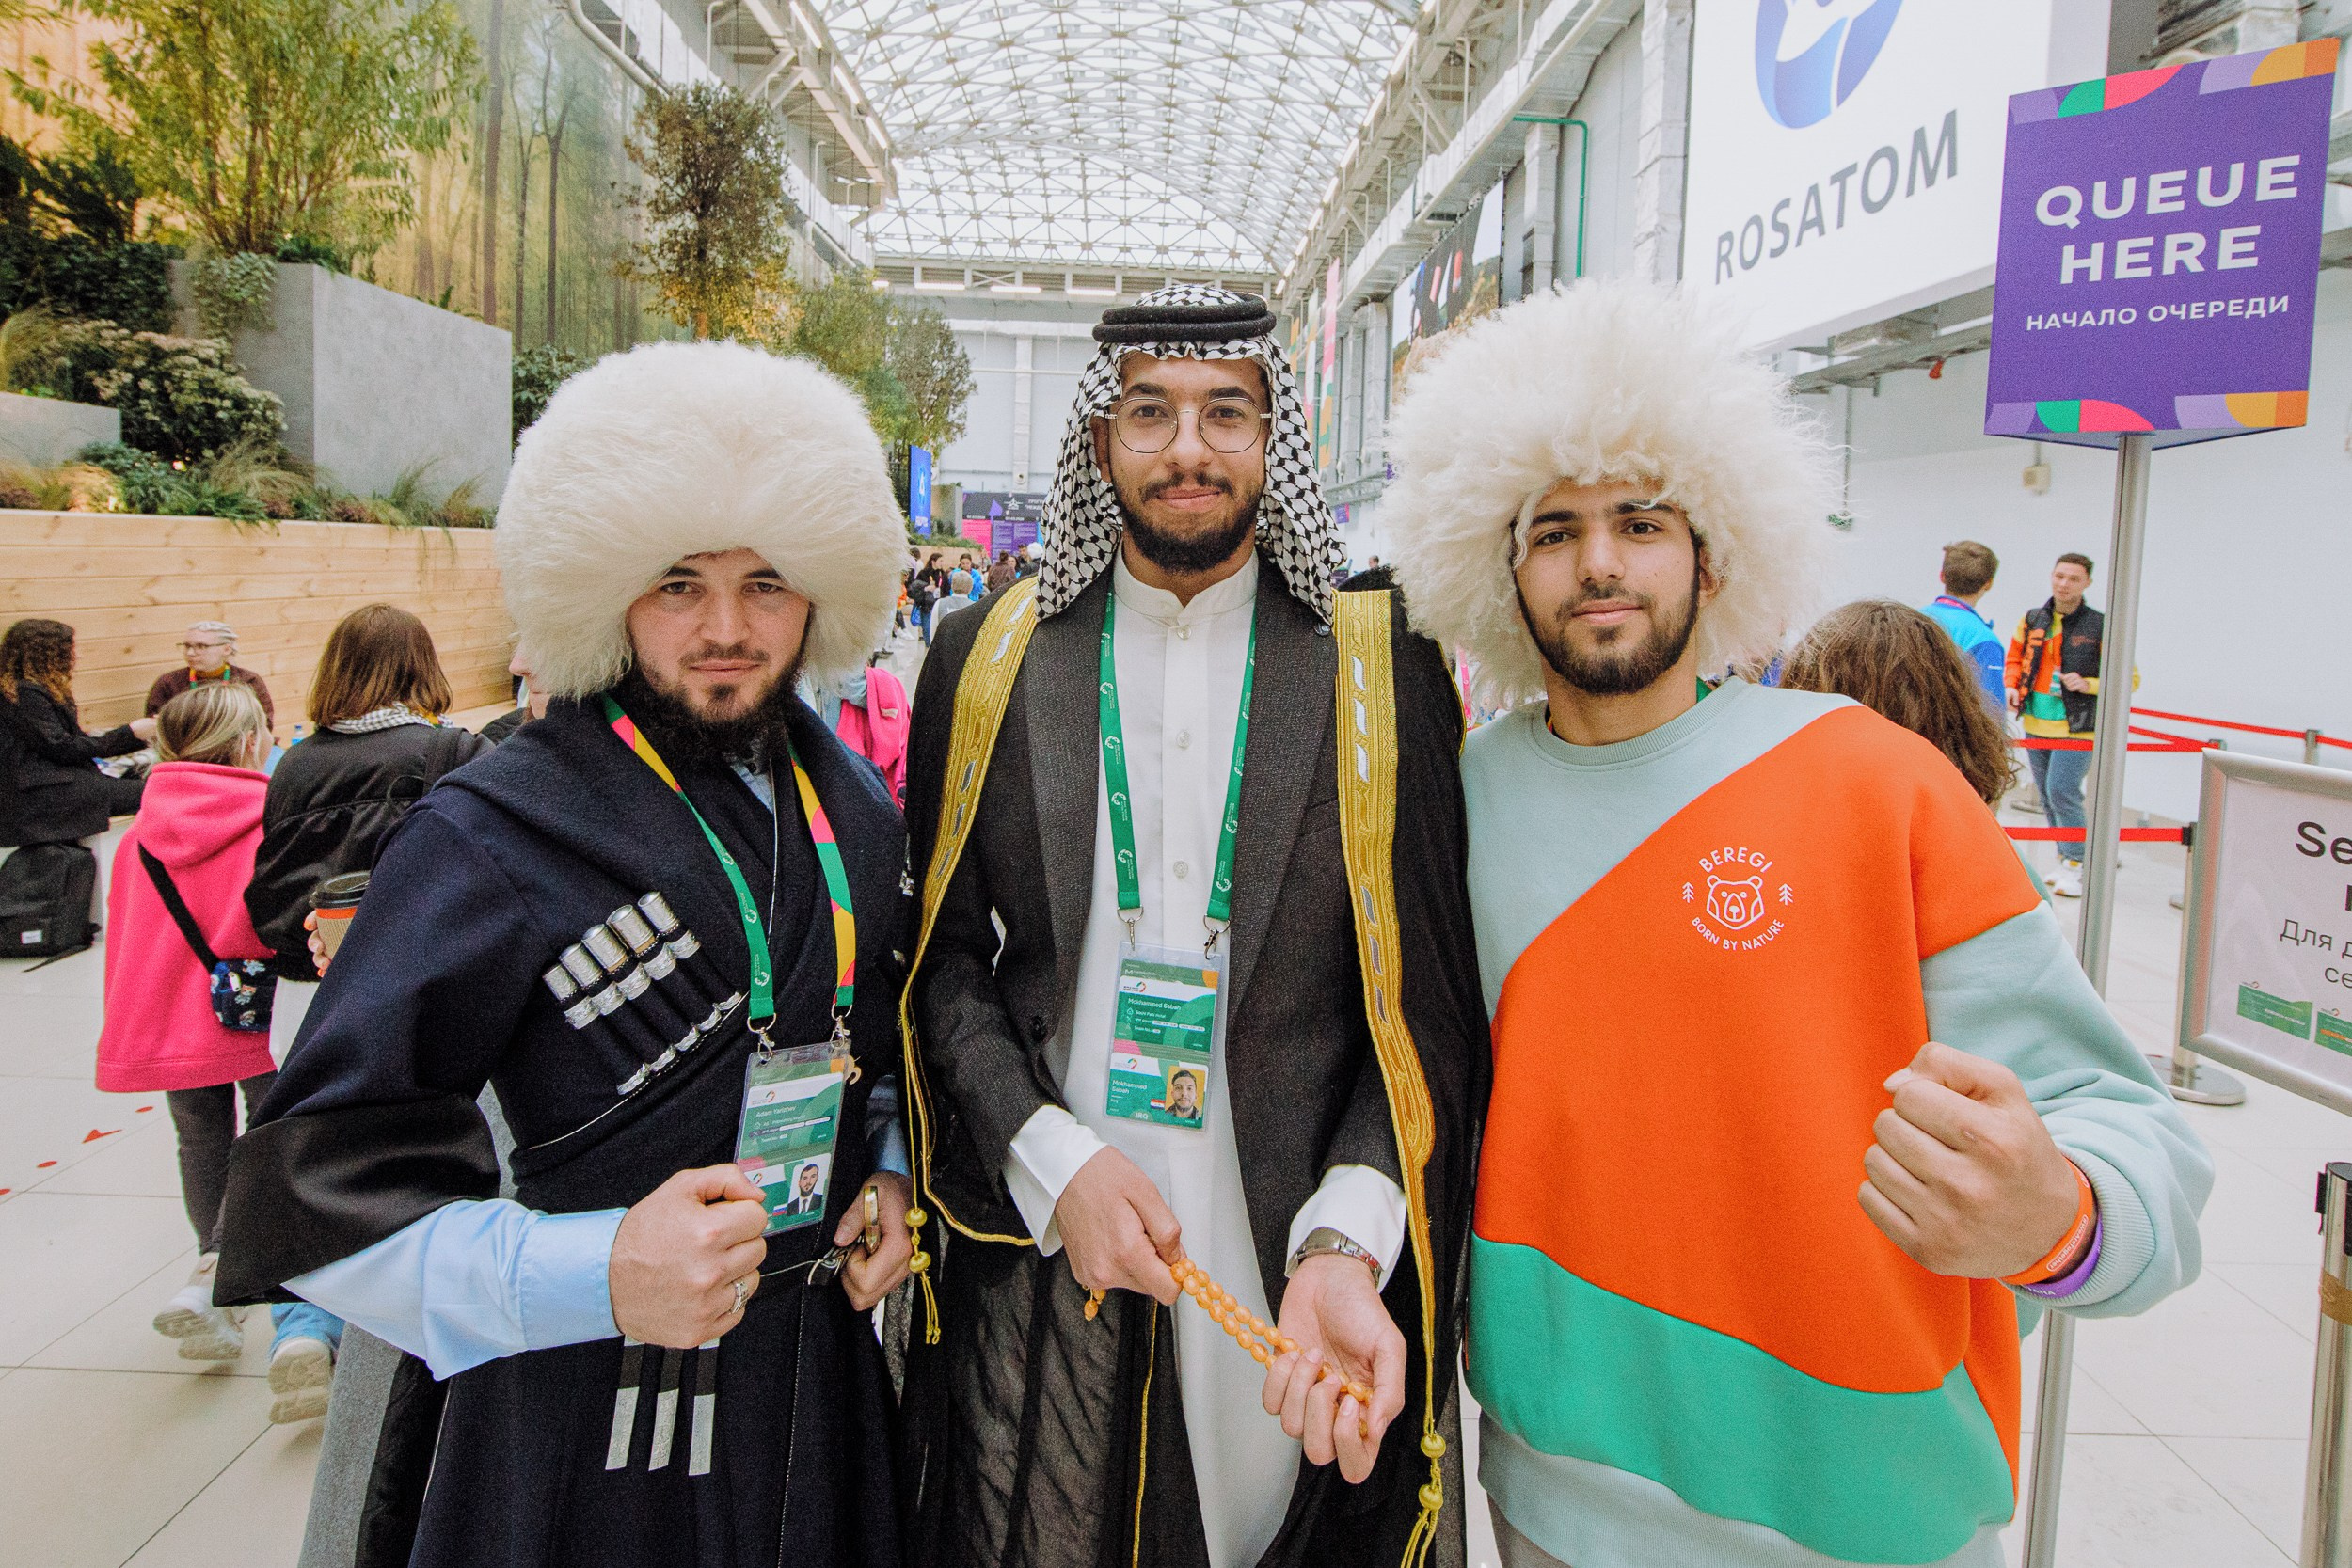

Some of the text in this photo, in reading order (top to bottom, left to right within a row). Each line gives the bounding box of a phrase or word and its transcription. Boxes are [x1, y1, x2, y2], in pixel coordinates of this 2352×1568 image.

[1715, 109, 1959, 285] ROSATOM
[2035, 154, 2301, 229] QUEUE
[2060, 225, 2261, 284] HERE
[2026, 295, 2290, 331] НАЧАЛО ОЧЕРЕДИ
[1698, 847, 1773, 873] BEREGI
[1691, 917, 1785, 951] BORN BY NATURE
[2280, 919, 2332, 951] Для
[1135, 1112, 1149, 1120] IRQ
[2050, 1216, 2088, 1269] #WeAreTogether
